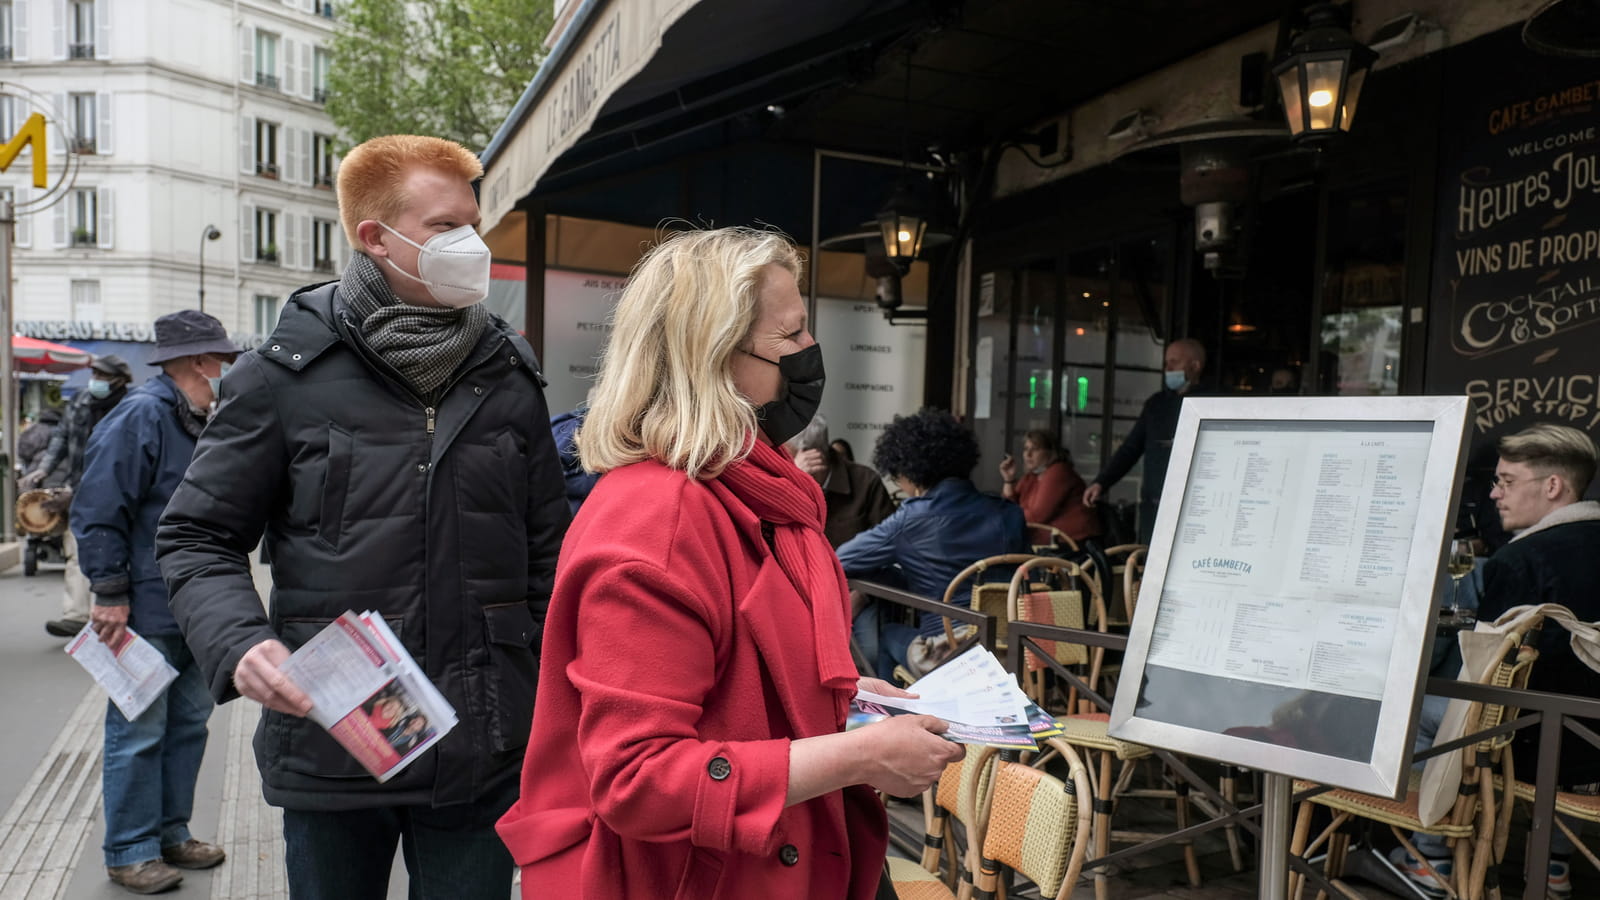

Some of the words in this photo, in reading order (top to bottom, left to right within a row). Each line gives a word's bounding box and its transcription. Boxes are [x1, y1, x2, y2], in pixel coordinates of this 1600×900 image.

[560, 11, 621, 138] GAMBETTA
[1488, 101, 1532, 135] CAFE
[1507, 127, 1596, 158] WELCOME
[1458, 170, 1551, 233] Heures
[1456, 244, 1502, 276] VINS
[1507, 239, 1535, 270] DE
[1539, 229, 1600, 267] PROP
[14, 321, 93, 340] ONCEAU
[1511, 317, 1531, 344] &
[1532, 298, 1600, 339] SOFT
[1465, 374, 1600, 414] SERVIC
[1475, 401, 1521, 433] NON
[1192, 556, 1211, 569] CAFÉ
[1213, 558, 1252, 574] GAMBETTA
